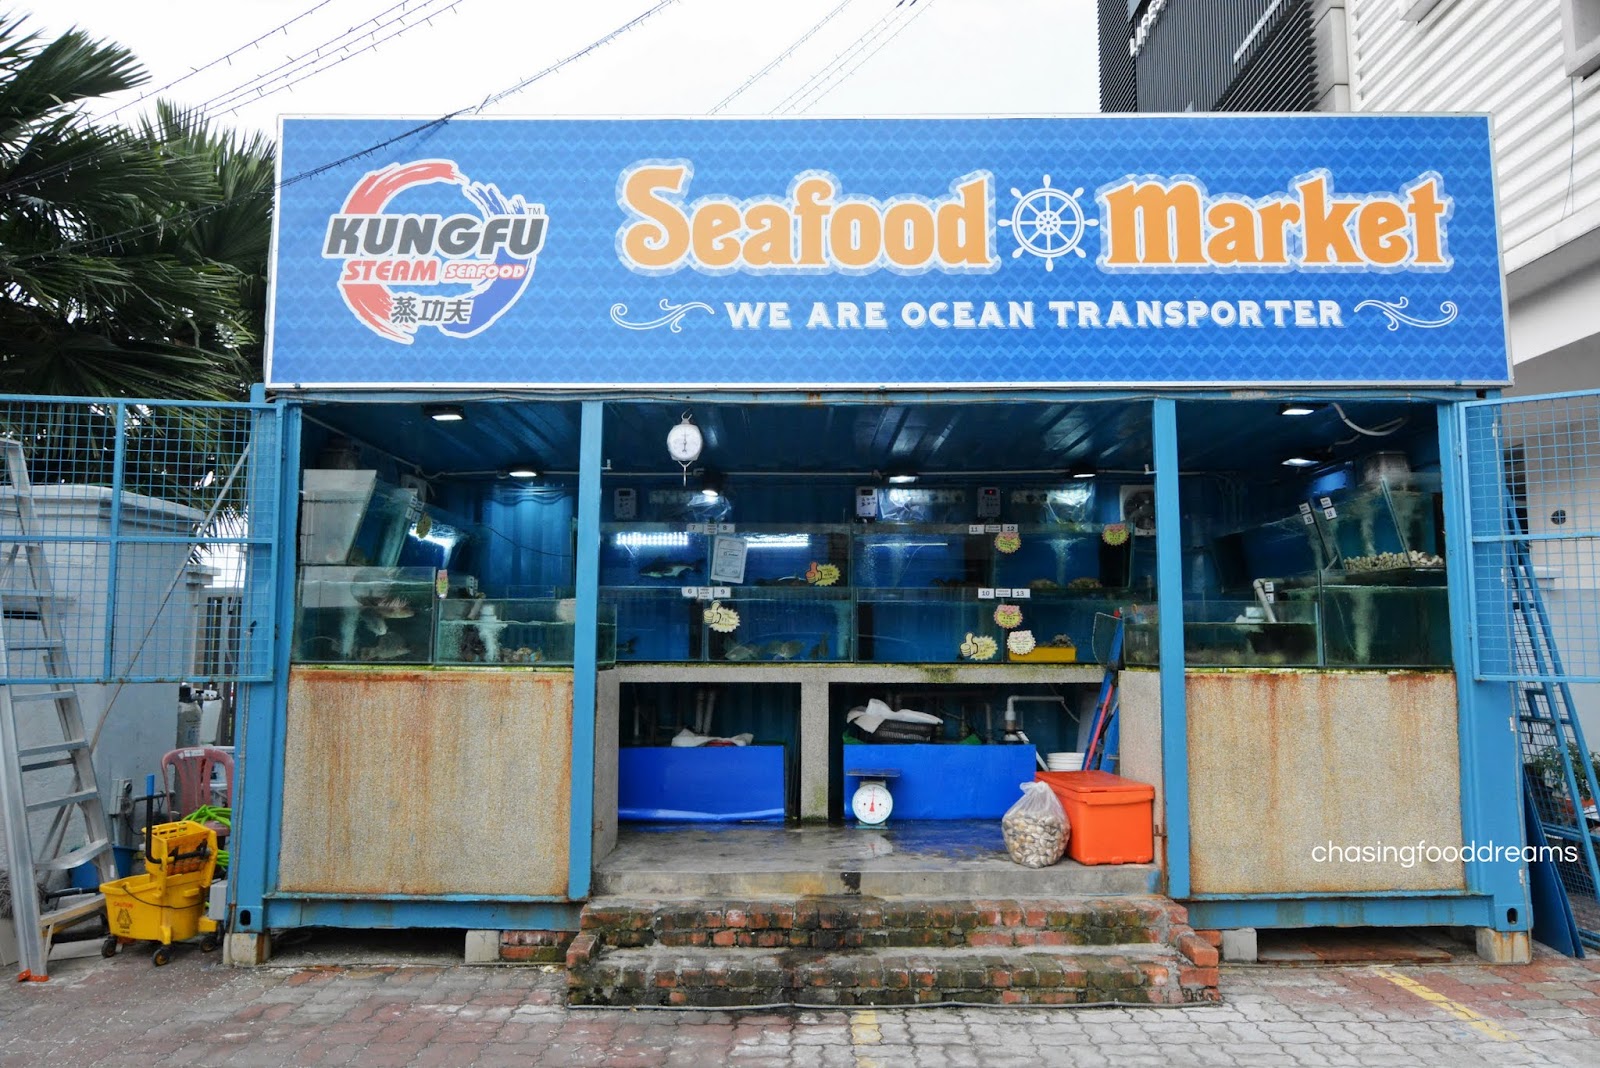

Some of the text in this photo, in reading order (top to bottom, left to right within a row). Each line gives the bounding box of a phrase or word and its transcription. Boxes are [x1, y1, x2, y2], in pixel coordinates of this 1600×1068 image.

[622, 163, 993, 269] Seafood
[324, 216, 546, 256] KUNGFU
[343, 259, 526, 281] STEAM SEAFOOD
[391, 297, 471, 324] 蒸功夫
[723, 300, 1345, 330] WE ARE OCEAN TRANSPORTER
